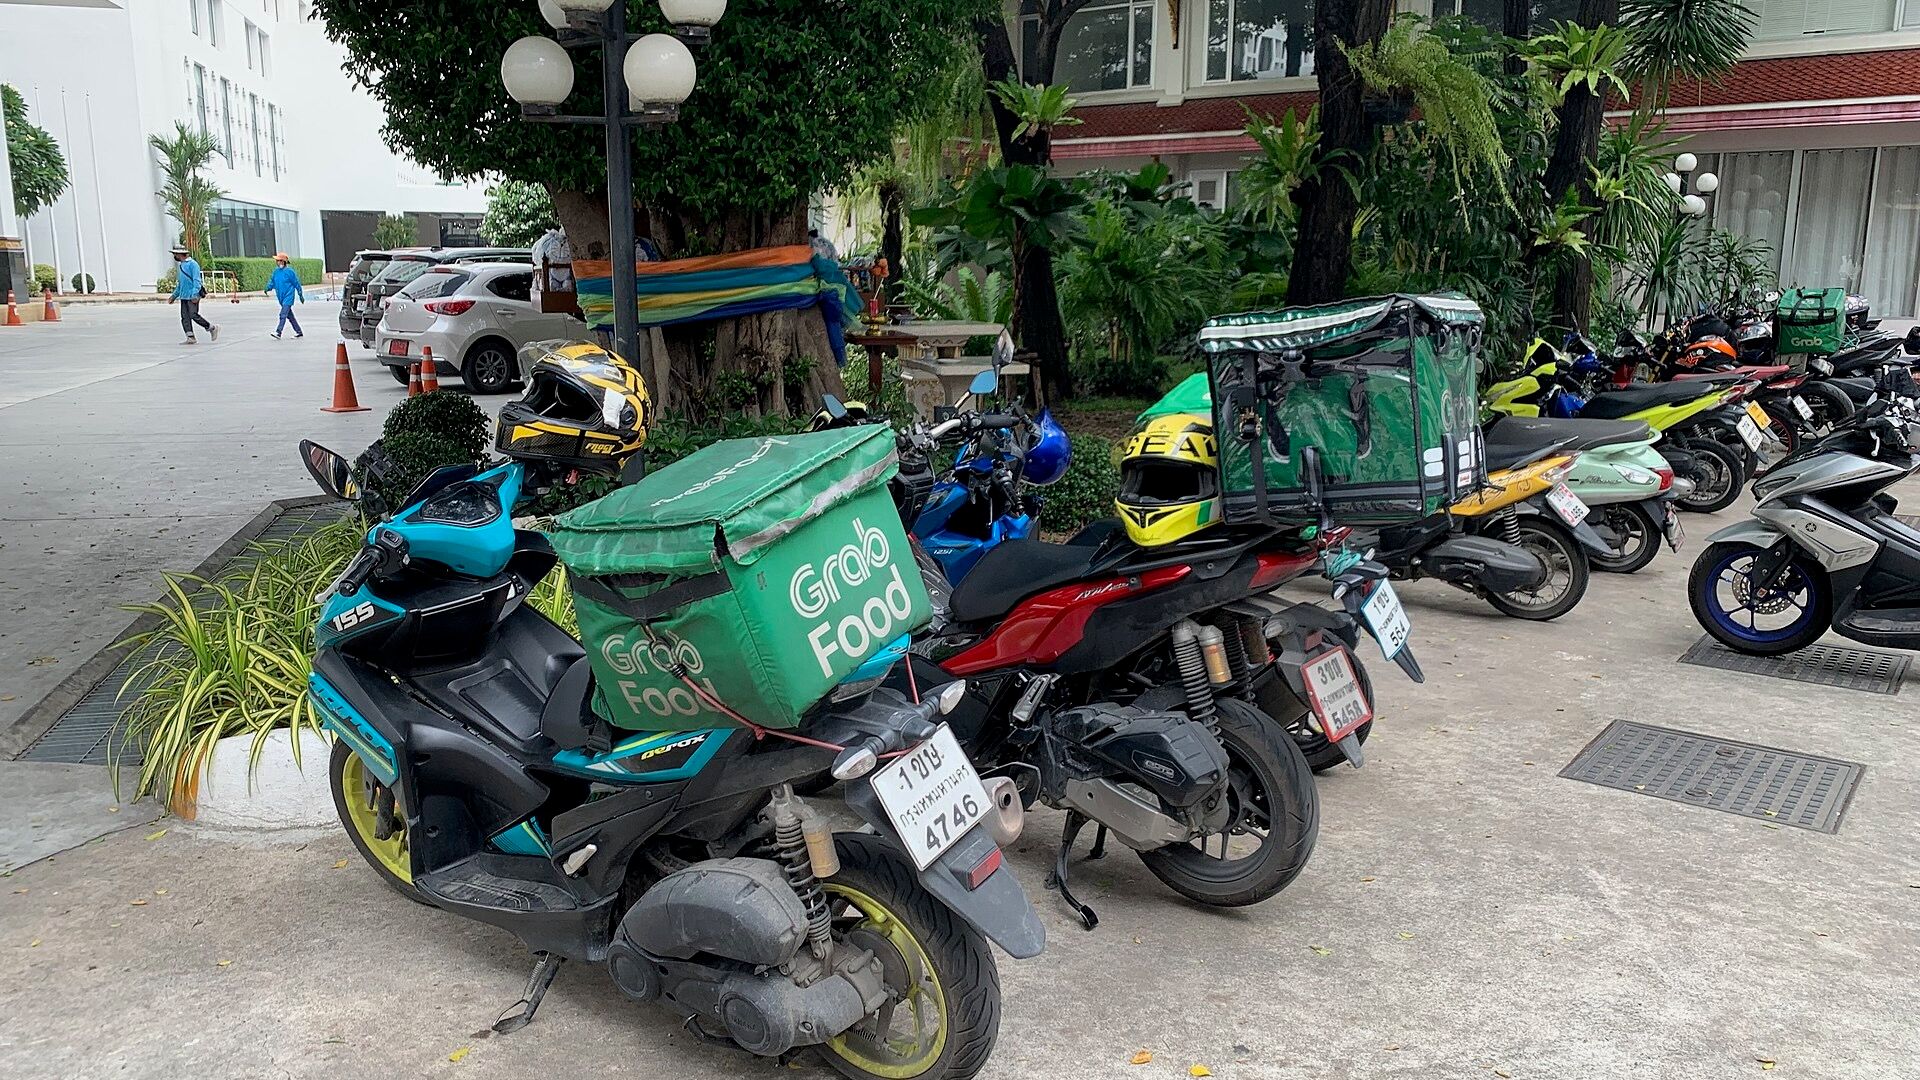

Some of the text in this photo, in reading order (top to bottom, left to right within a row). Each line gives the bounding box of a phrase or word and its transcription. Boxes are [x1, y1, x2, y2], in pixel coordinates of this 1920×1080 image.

[1790, 336, 1823, 347] Grab
[789, 517, 890, 619] Grab
[331, 600, 375, 632] 155
[807, 562, 912, 679] Food
[1389, 619, 1406, 647] 564
[602, 629, 704, 676] Grab
[617, 677, 722, 717] Food
[1331, 699, 1363, 730] 5458
[641, 733, 706, 761] aerox
[899, 764, 970, 829] กรุงเทพมหานคร
[925, 793, 979, 851] 4746
